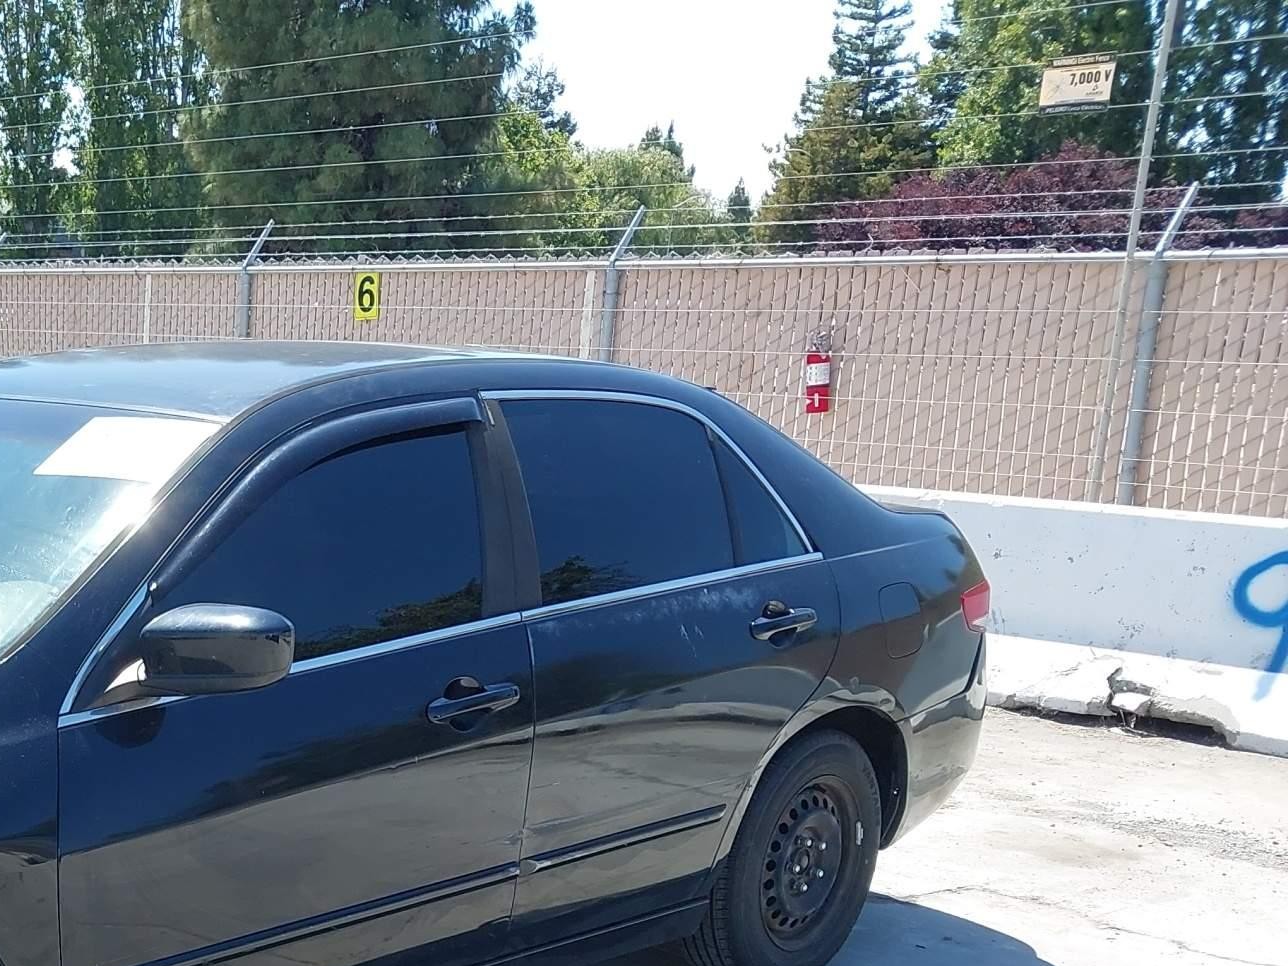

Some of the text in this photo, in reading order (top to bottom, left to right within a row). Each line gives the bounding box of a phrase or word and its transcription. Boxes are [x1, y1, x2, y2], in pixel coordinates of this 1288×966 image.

[1069, 70, 1101, 87] 7,000
[1105, 69, 1113, 81] V
[358, 275, 375, 313] 6
